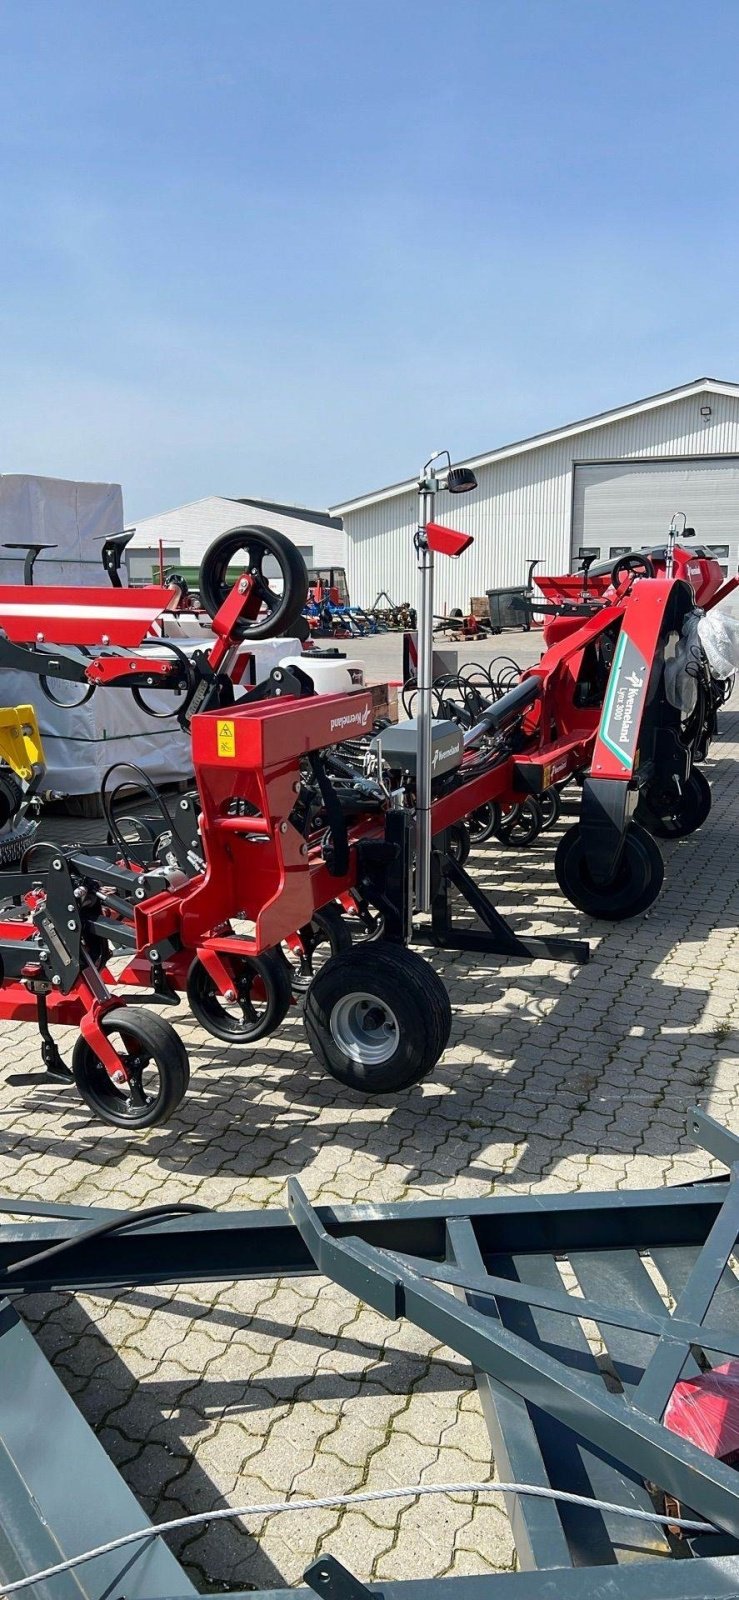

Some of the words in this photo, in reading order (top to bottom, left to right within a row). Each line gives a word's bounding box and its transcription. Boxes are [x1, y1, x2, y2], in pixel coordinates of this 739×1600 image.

[617, 687, 628, 703] Lynx
[330, 711, 362, 731] Kverneland
[614, 704, 624, 721] 3000
[619, 688, 639, 743] Kverneland
